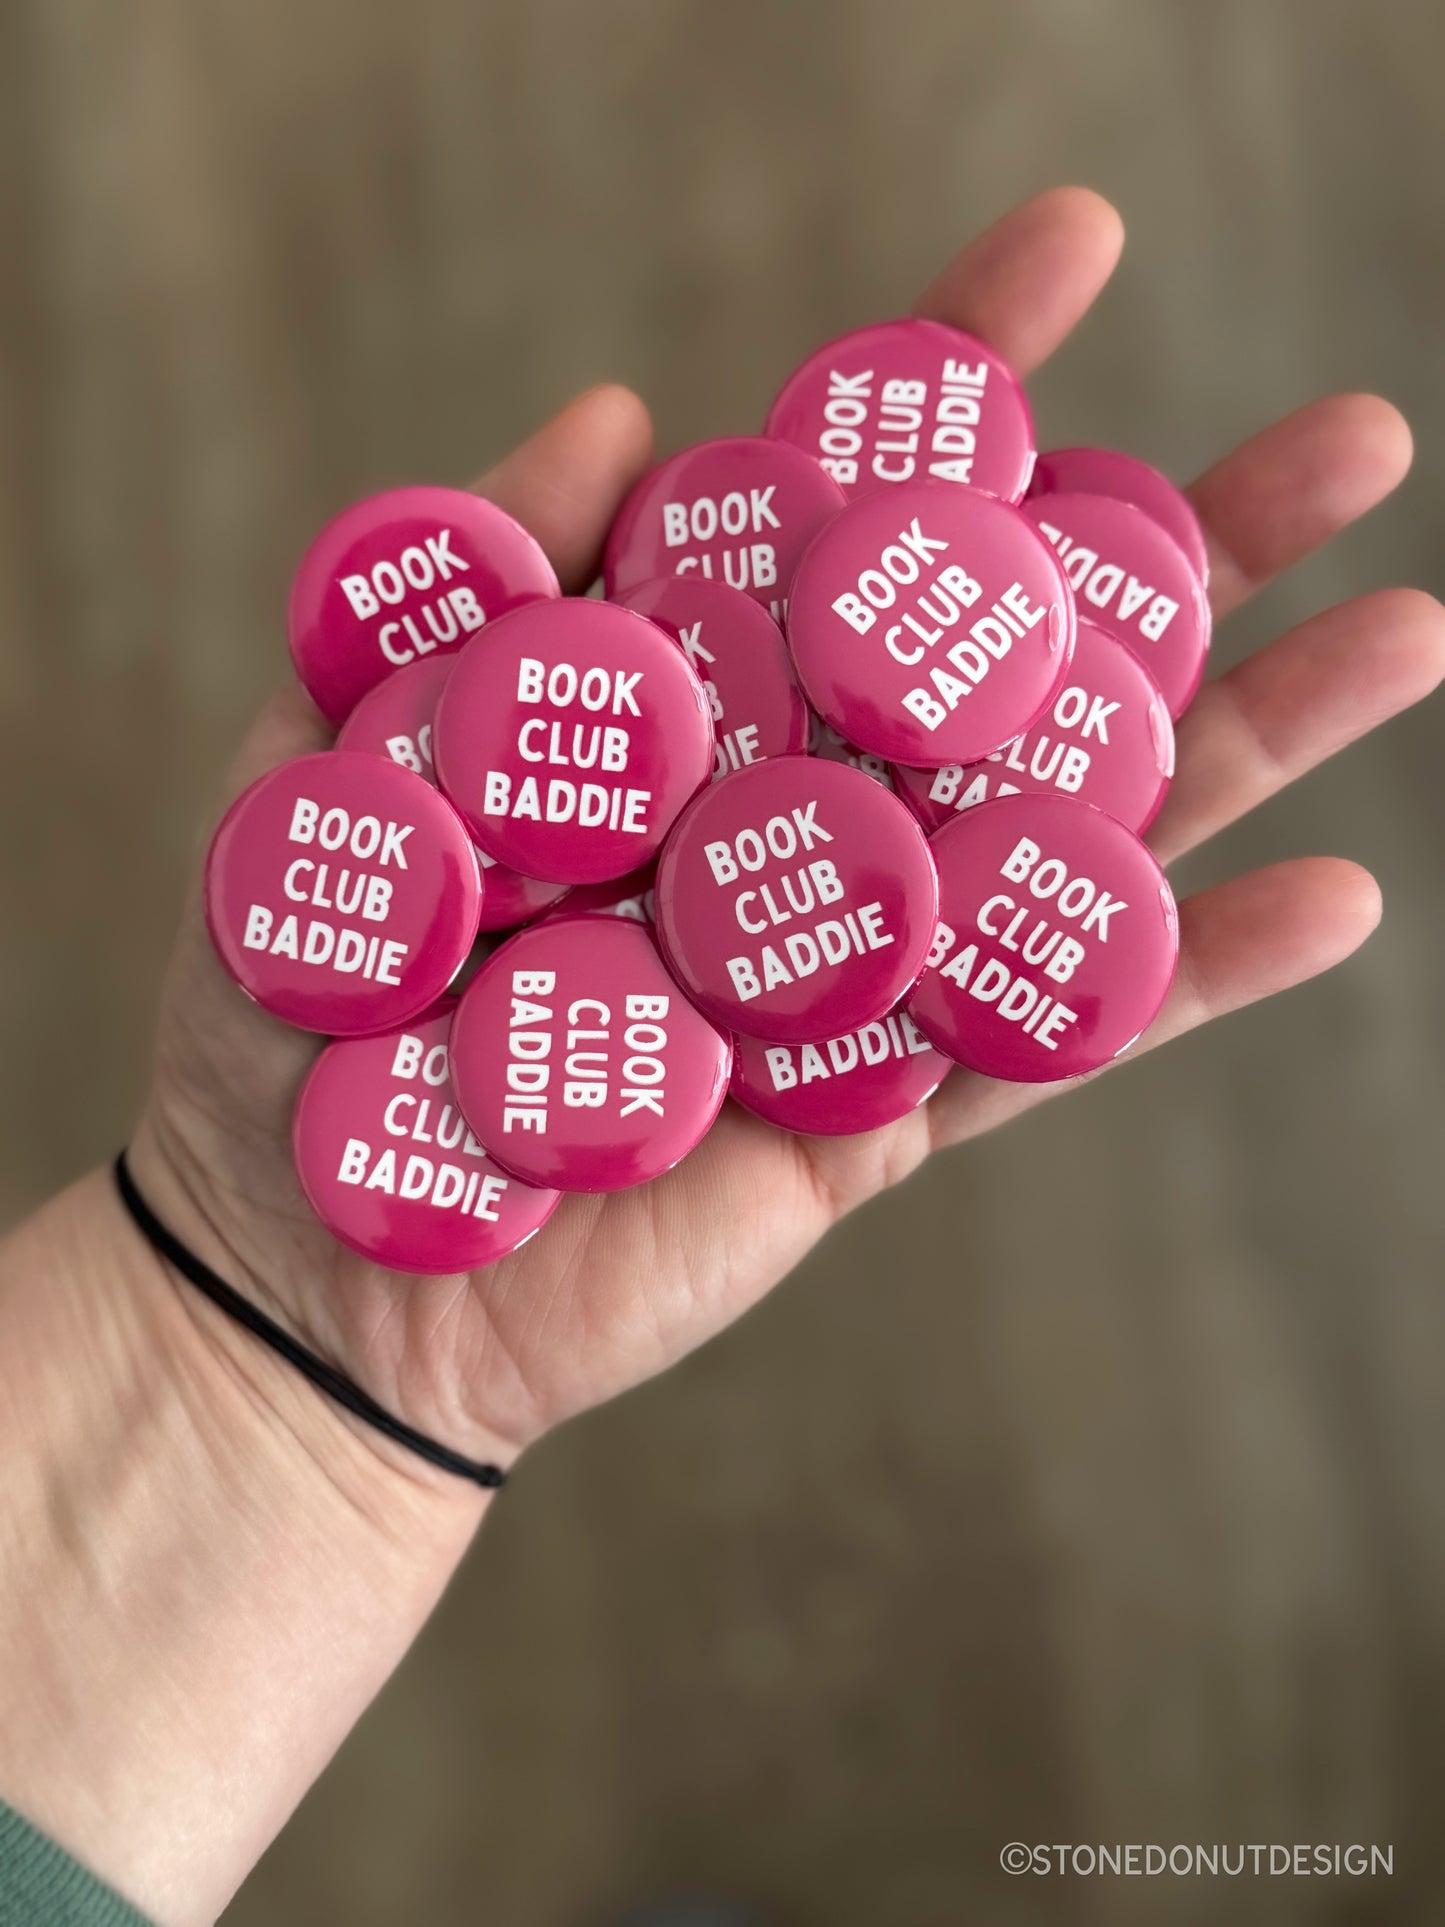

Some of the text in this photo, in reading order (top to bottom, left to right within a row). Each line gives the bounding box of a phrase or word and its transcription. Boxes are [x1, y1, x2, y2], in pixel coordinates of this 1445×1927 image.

[819, 369, 874, 484] BOOK
[872, 378, 927, 482] CLUB
[928, 359, 988, 484] ADDIE
[663, 485, 782, 547] BOOK
[340, 530, 470, 620] BOOK
[831, 517, 949, 636] BOOK
[884, 565, 984, 667] CLUB
[379, 587, 486, 665] CLUB
[901, 582, 1047, 731] BADDIE
[517, 658, 644, 717] BOOK
[1053, 686, 1121, 745] OK
[518, 719, 630, 772] CLUB
[289, 798, 415, 869] BOOK
[484, 771, 651, 833] BADDIE
[704, 800, 834, 886] BOOK
[284, 859, 393, 922] CLUB
[735, 859, 844, 934] CLUB
[1000, 837, 1129, 943] BOOK
[243, 904, 408, 985] BADDIE
[726, 902, 894, 1002] BADDIE
[976, 894, 1086, 985] CLUB
[925, 921, 1078, 1050] BADDIE
[391, 1034, 449, 1086] BO
[503, 971, 556, 1134] BADDIE
[563, 999, 611, 1108] CLUB
[620, 995, 669, 1118] BOOK
[765, 1013, 932, 1091] BADDIE
[337, 1138, 508, 1222] BADDIE
